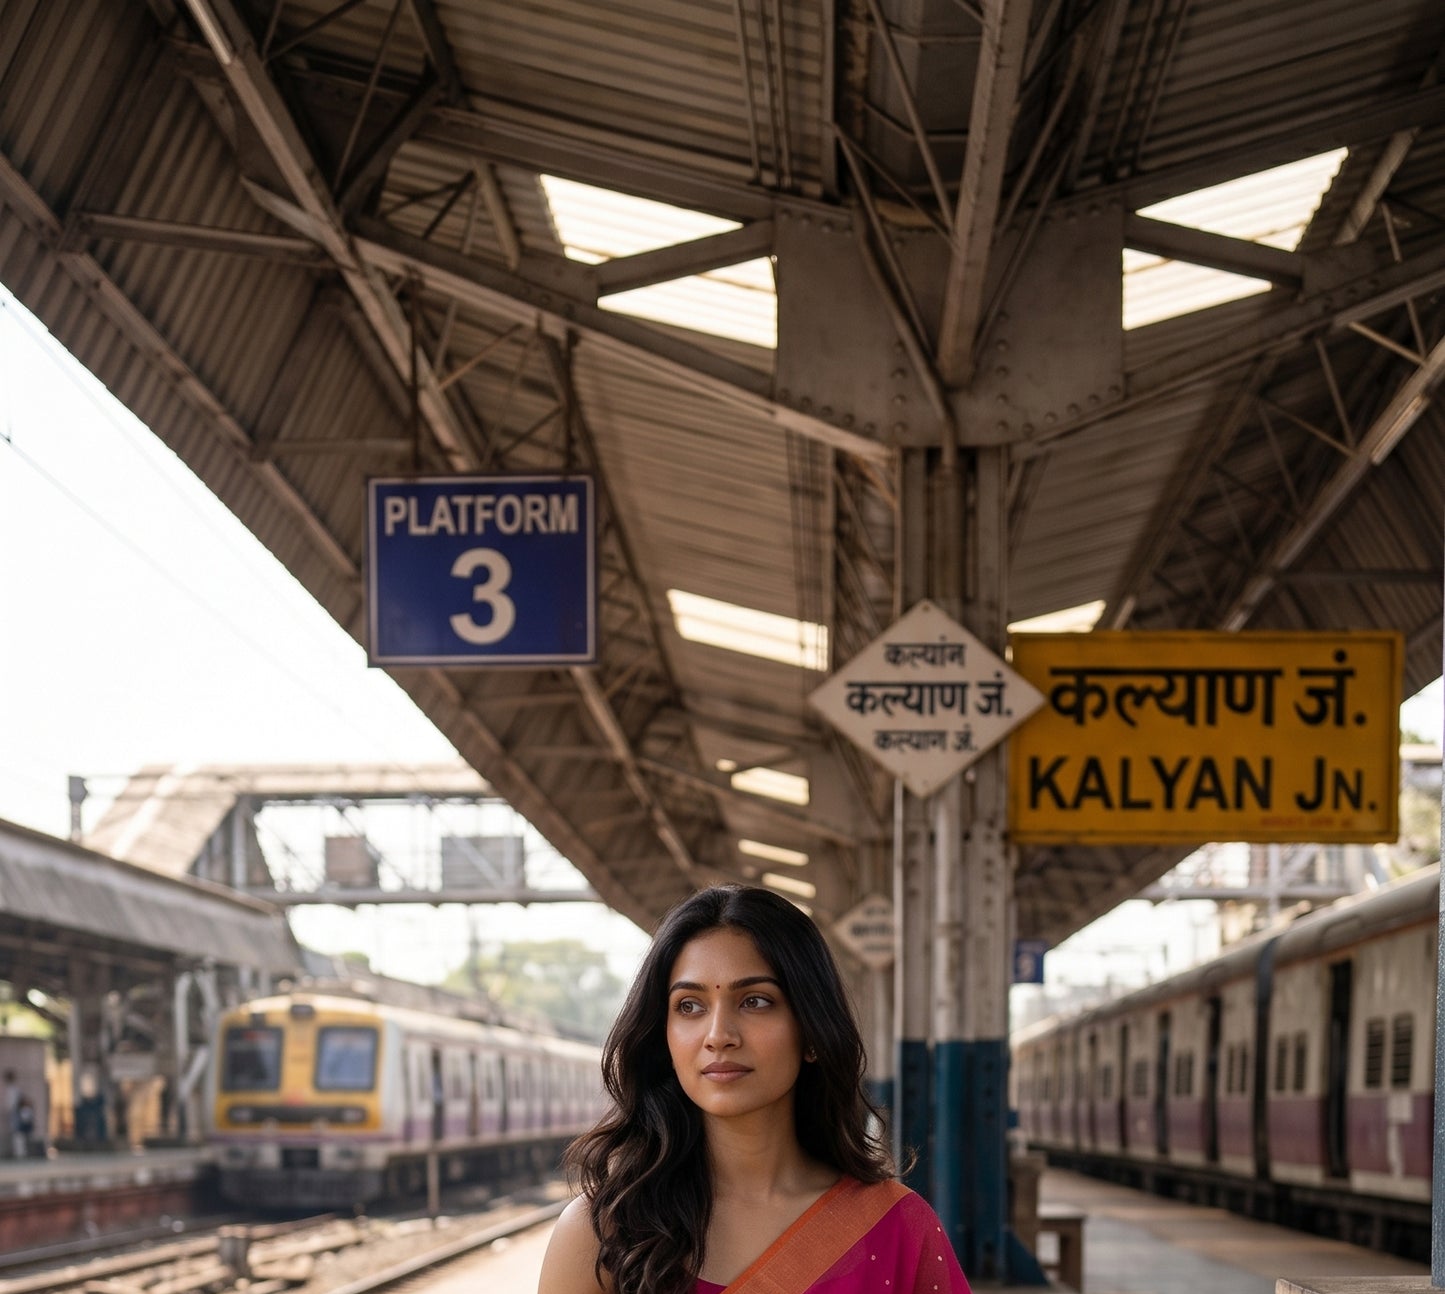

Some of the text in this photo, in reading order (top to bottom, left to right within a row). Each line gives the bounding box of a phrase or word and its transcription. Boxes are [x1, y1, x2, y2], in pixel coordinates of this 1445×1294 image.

[384, 494, 579, 536] PLATFORM
[449, 547, 516, 645] 3
[846, 682, 969, 716] कल्याण
[1049, 649, 1367, 728] कल्याण जं.
[1028, 757, 1273, 811] KALYAN
